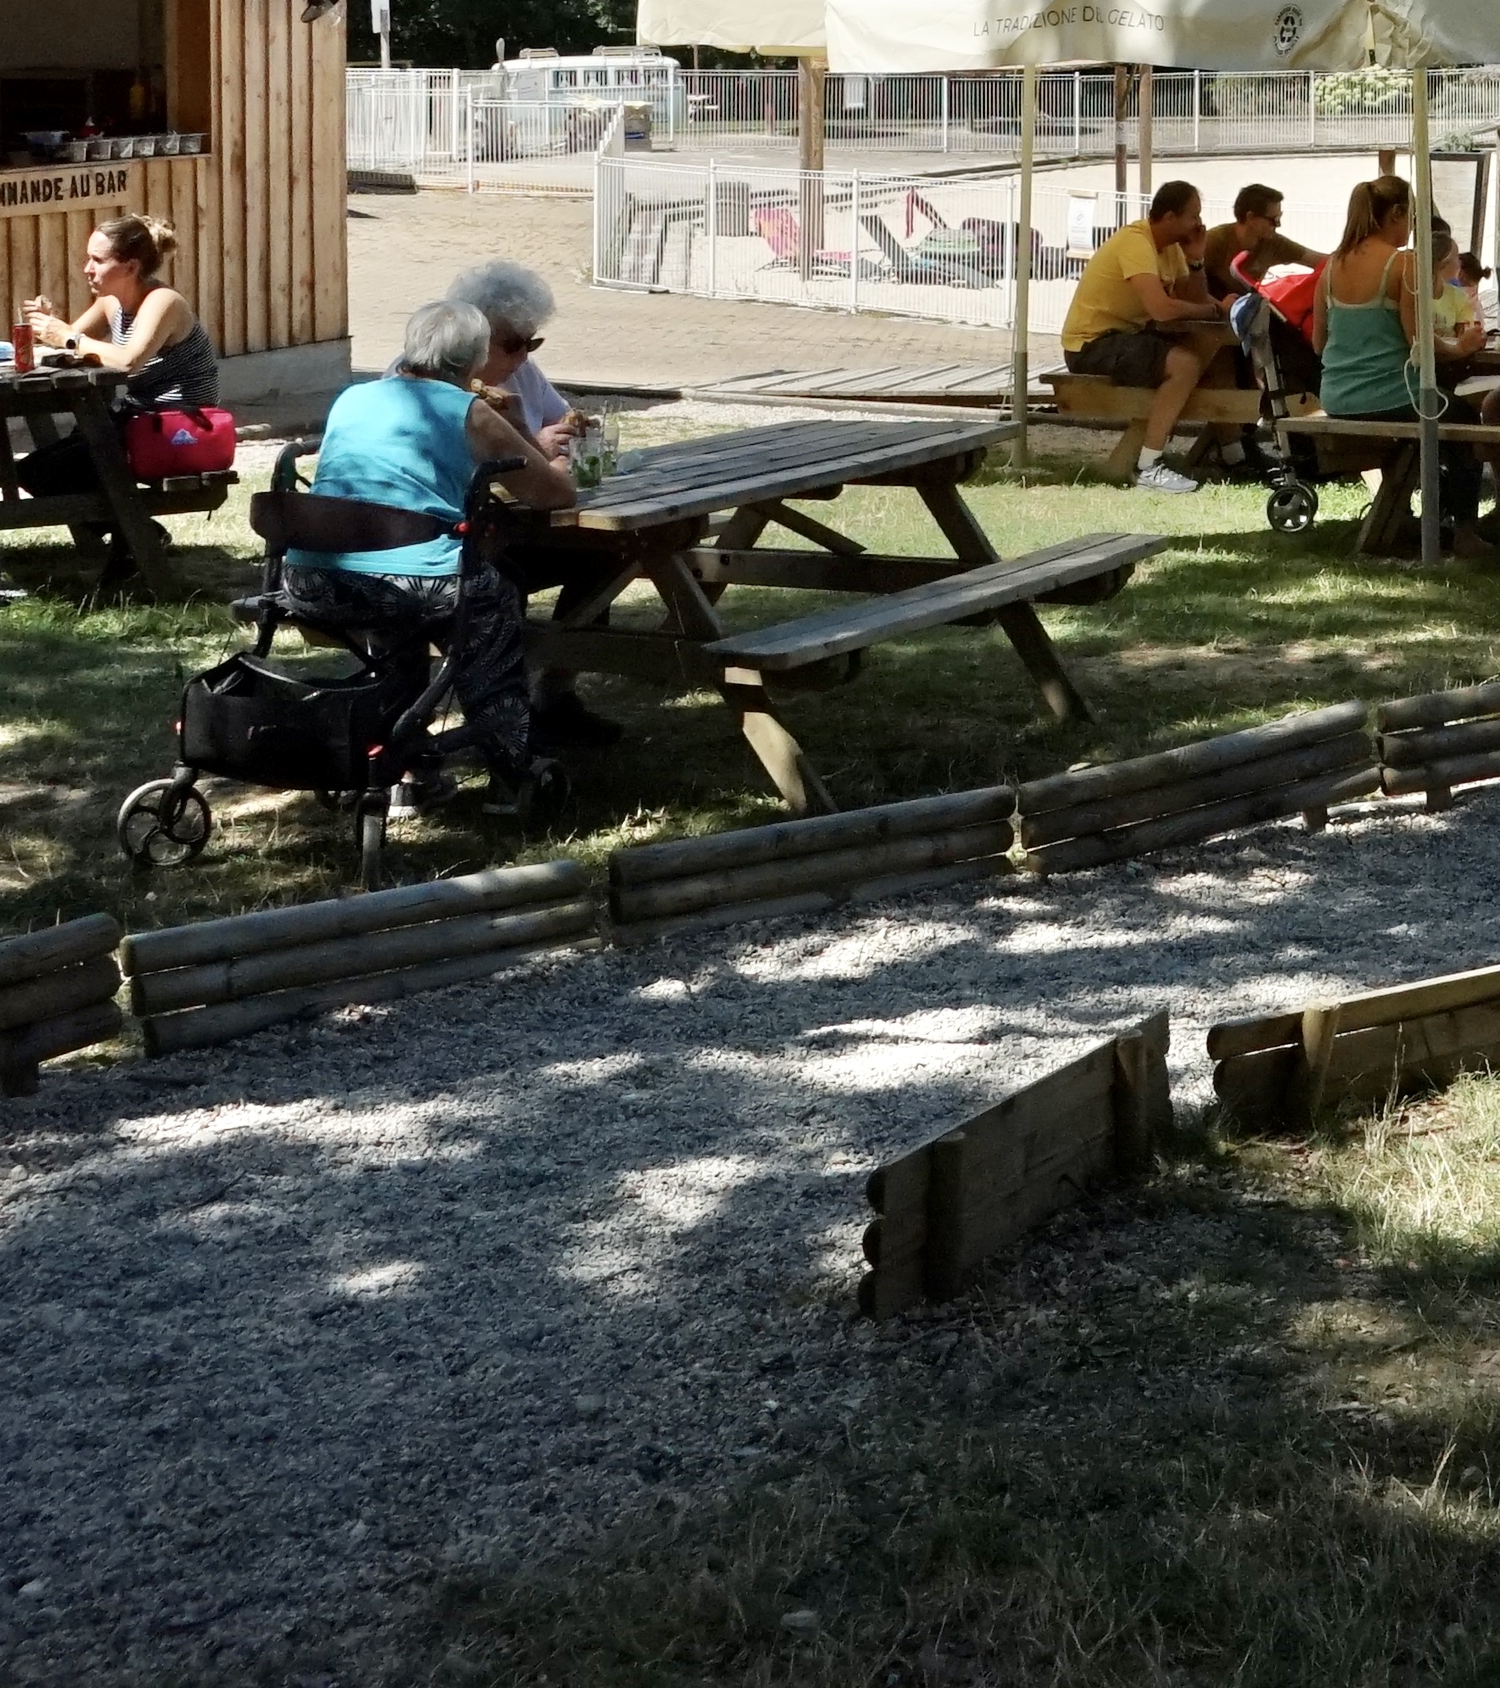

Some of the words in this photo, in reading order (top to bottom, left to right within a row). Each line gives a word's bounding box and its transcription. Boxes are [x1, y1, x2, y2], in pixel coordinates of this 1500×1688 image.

[973, 21, 990, 37] LA
[996, 6, 1077, 35] TRADIZIONE
[1108, 8, 1165, 32] GELATO
[70, 174, 90, 199] AU
[95, 170, 127, 195] BAR
